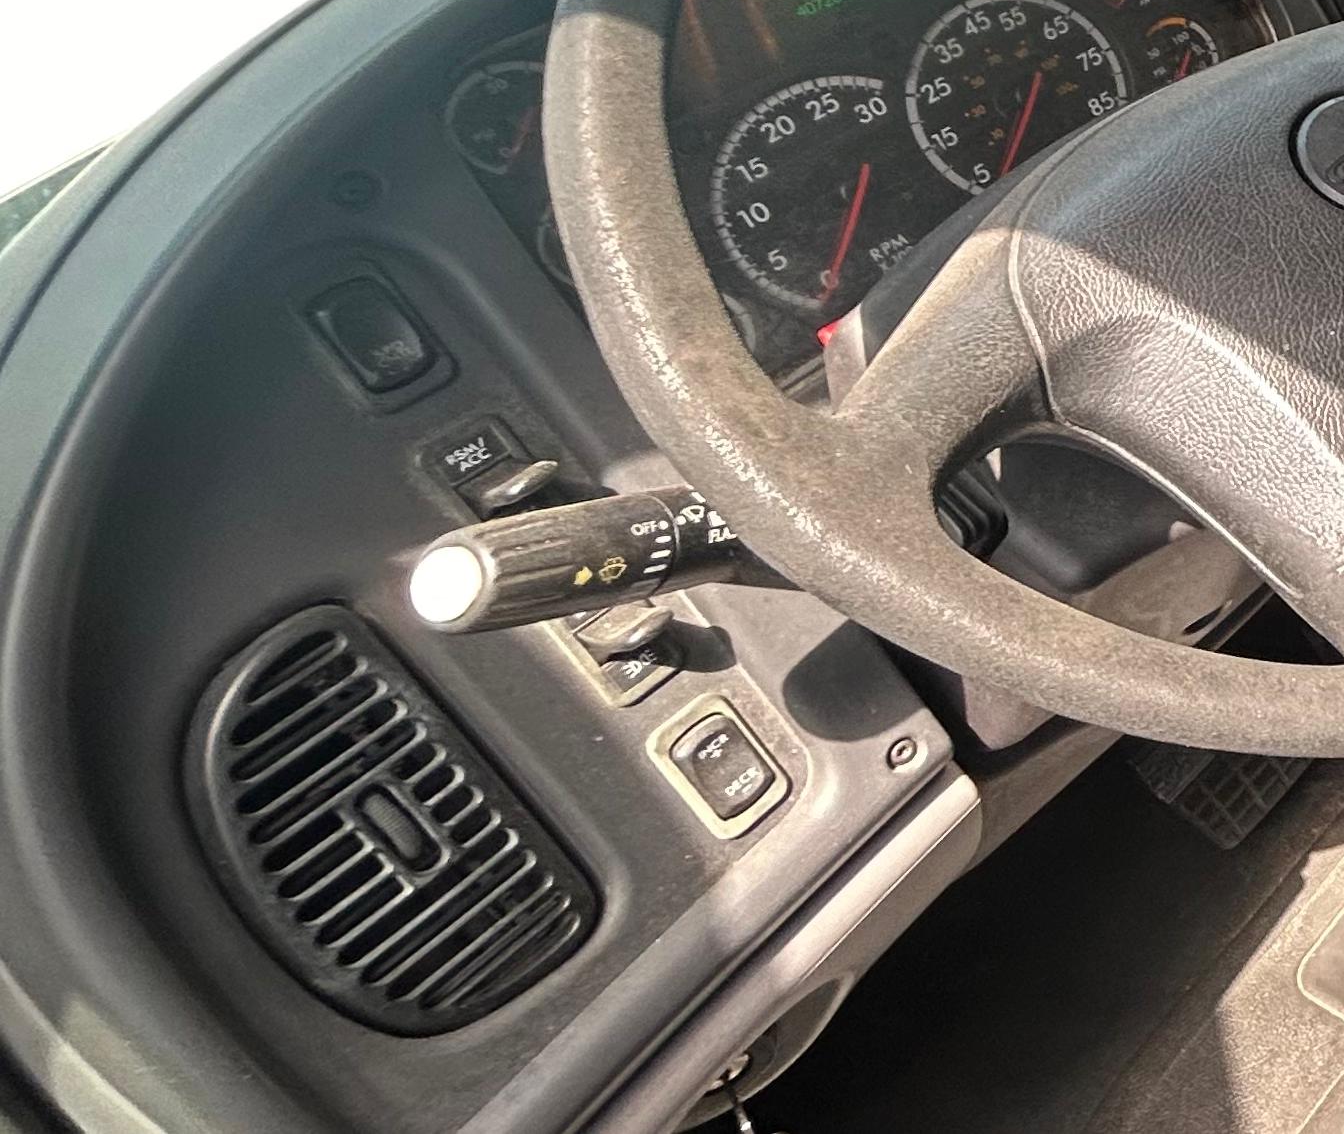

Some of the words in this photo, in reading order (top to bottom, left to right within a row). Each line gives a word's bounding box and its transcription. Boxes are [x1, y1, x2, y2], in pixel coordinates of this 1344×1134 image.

[965, 10, 992, 35] 45
[999, 6, 1027, 32] 55
[1042, 15, 1070, 40] 65
[933, 37, 964, 64] 35
[1075, 46, 1103, 72] 75
[920, 76, 952, 105] 25
[805, 92, 841, 121] 25
[853, 96, 888, 124] 30
[1087, 91, 1115, 117] 85
[759, 115, 796, 144] 20
[930, 126, 960, 151] 15
[735, 156, 769, 184] 15
[973, 163, 992, 184] 5
[736, 202, 771, 229] 10
[767, 249, 788, 271] 5
[868, 233, 910, 263] RPM
[444, 436, 485, 466] RSM/
[459, 447, 493, 473] ACC
[630, 520, 659, 537] OFF
[724, 766, 761, 798] DECR
